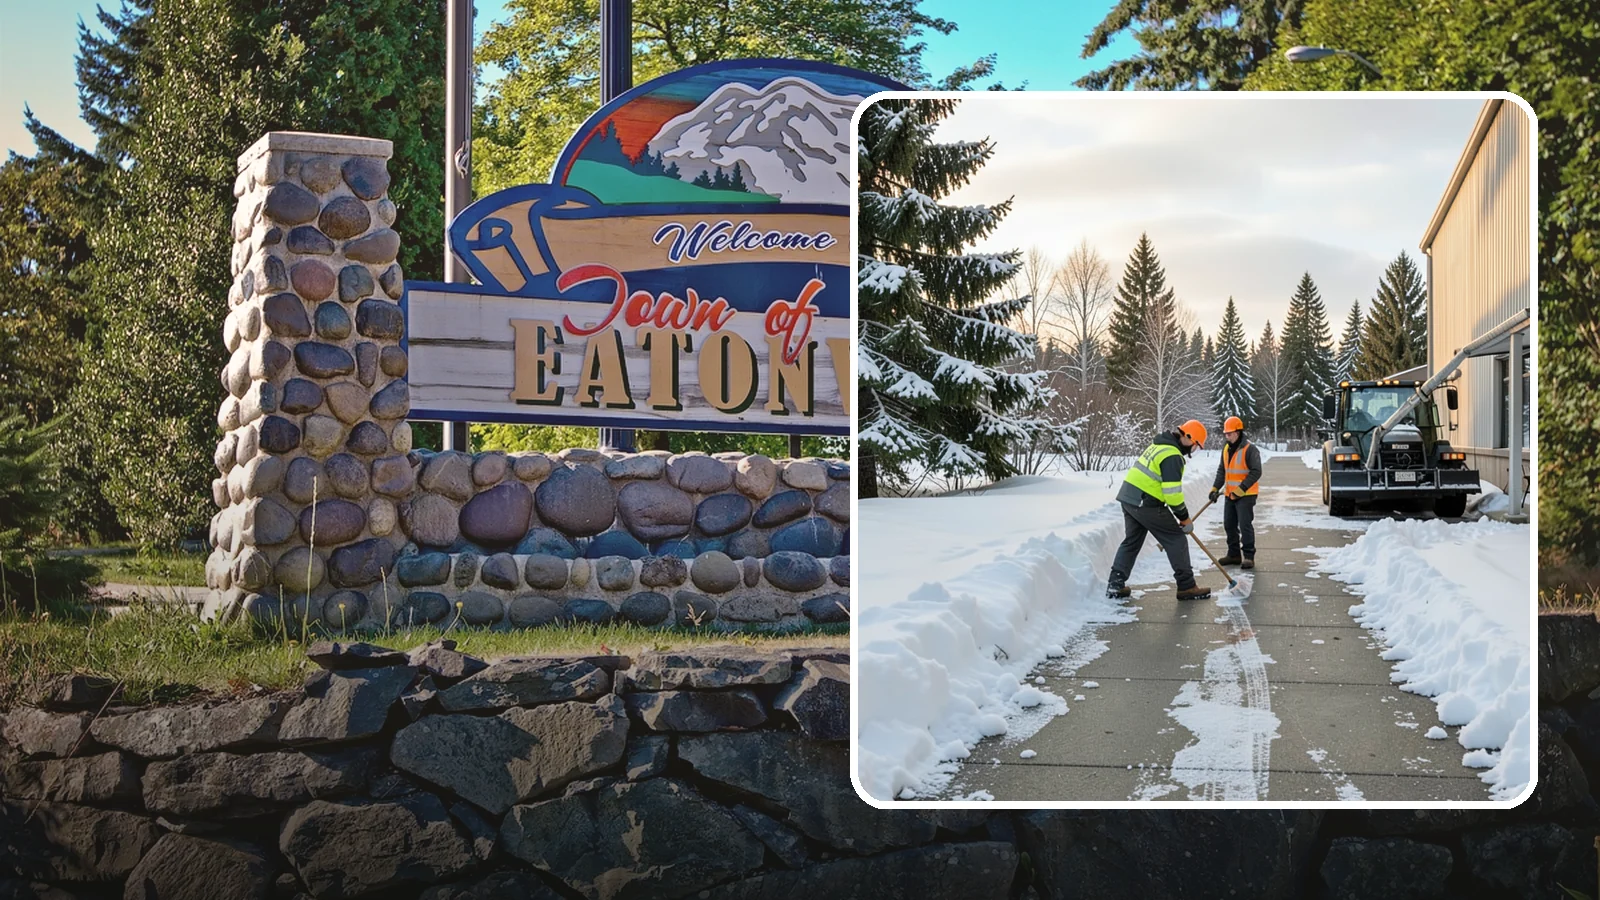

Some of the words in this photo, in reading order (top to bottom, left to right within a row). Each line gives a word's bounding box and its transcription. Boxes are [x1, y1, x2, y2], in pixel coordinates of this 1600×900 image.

[653, 220, 837, 263] Welcome
[556, 263, 737, 336] Town
[764, 278, 826, 366] of
